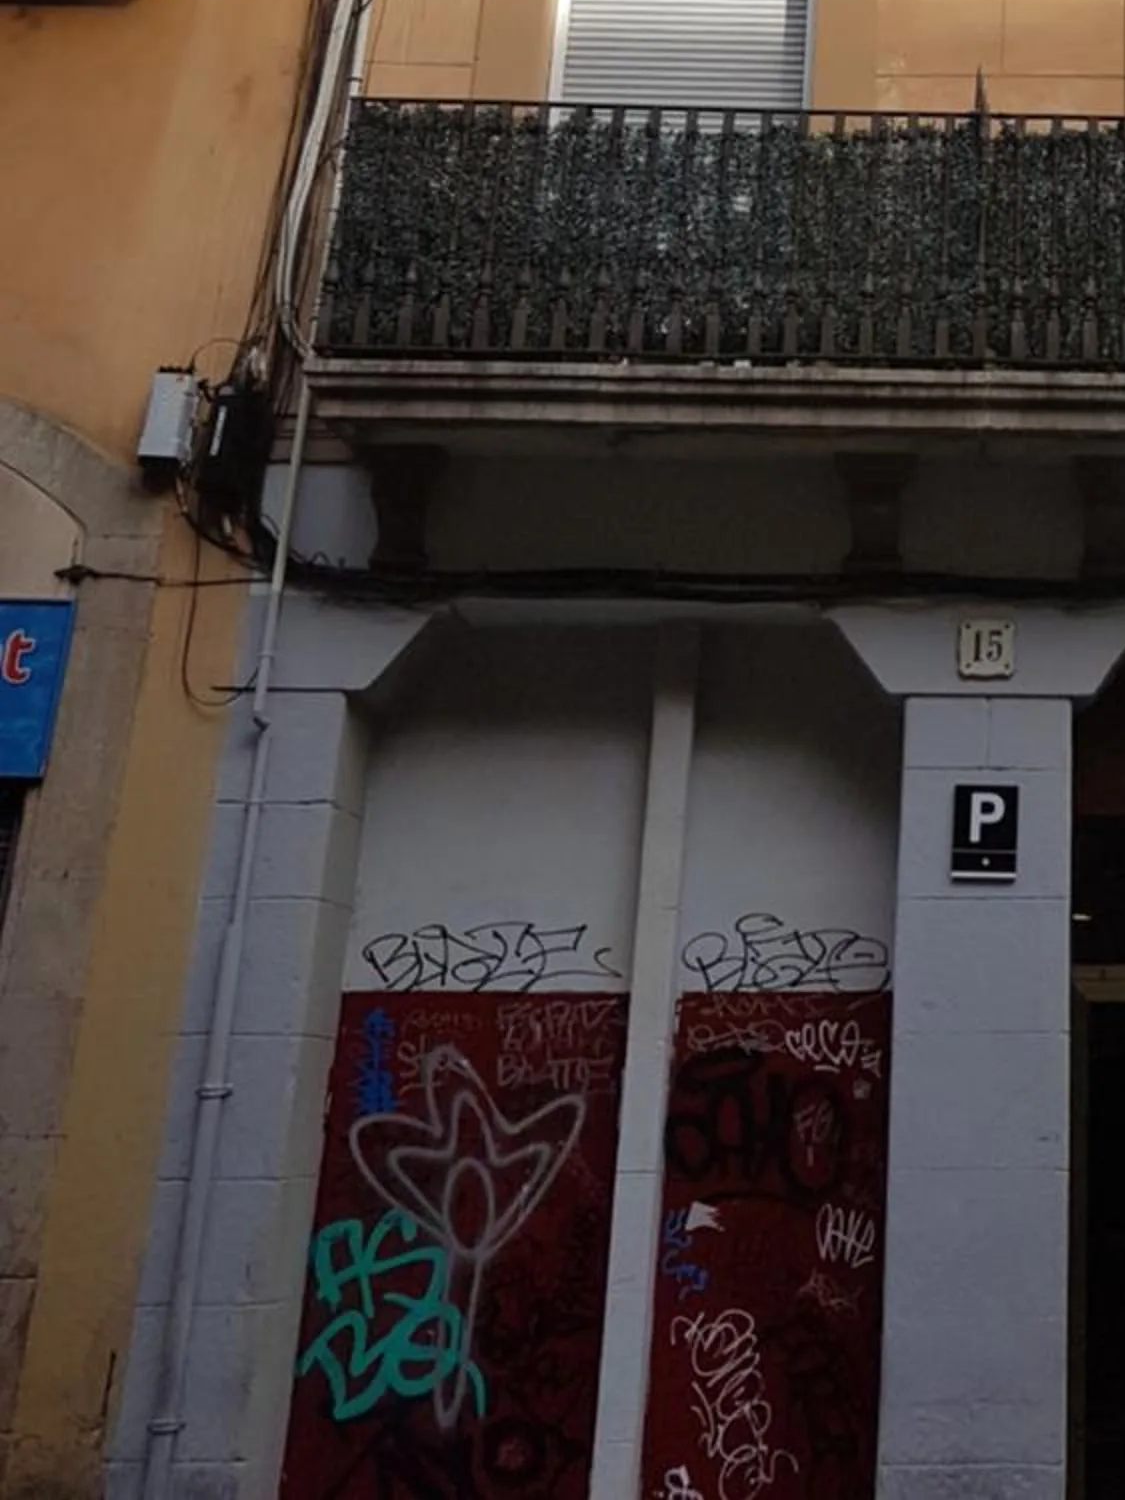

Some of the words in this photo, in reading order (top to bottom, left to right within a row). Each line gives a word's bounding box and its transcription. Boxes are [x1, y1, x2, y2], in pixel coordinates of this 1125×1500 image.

[0, 628, 36, 685] t
[972, 630, 1003, 662] 15
[969, 792, 1005, 843] P
